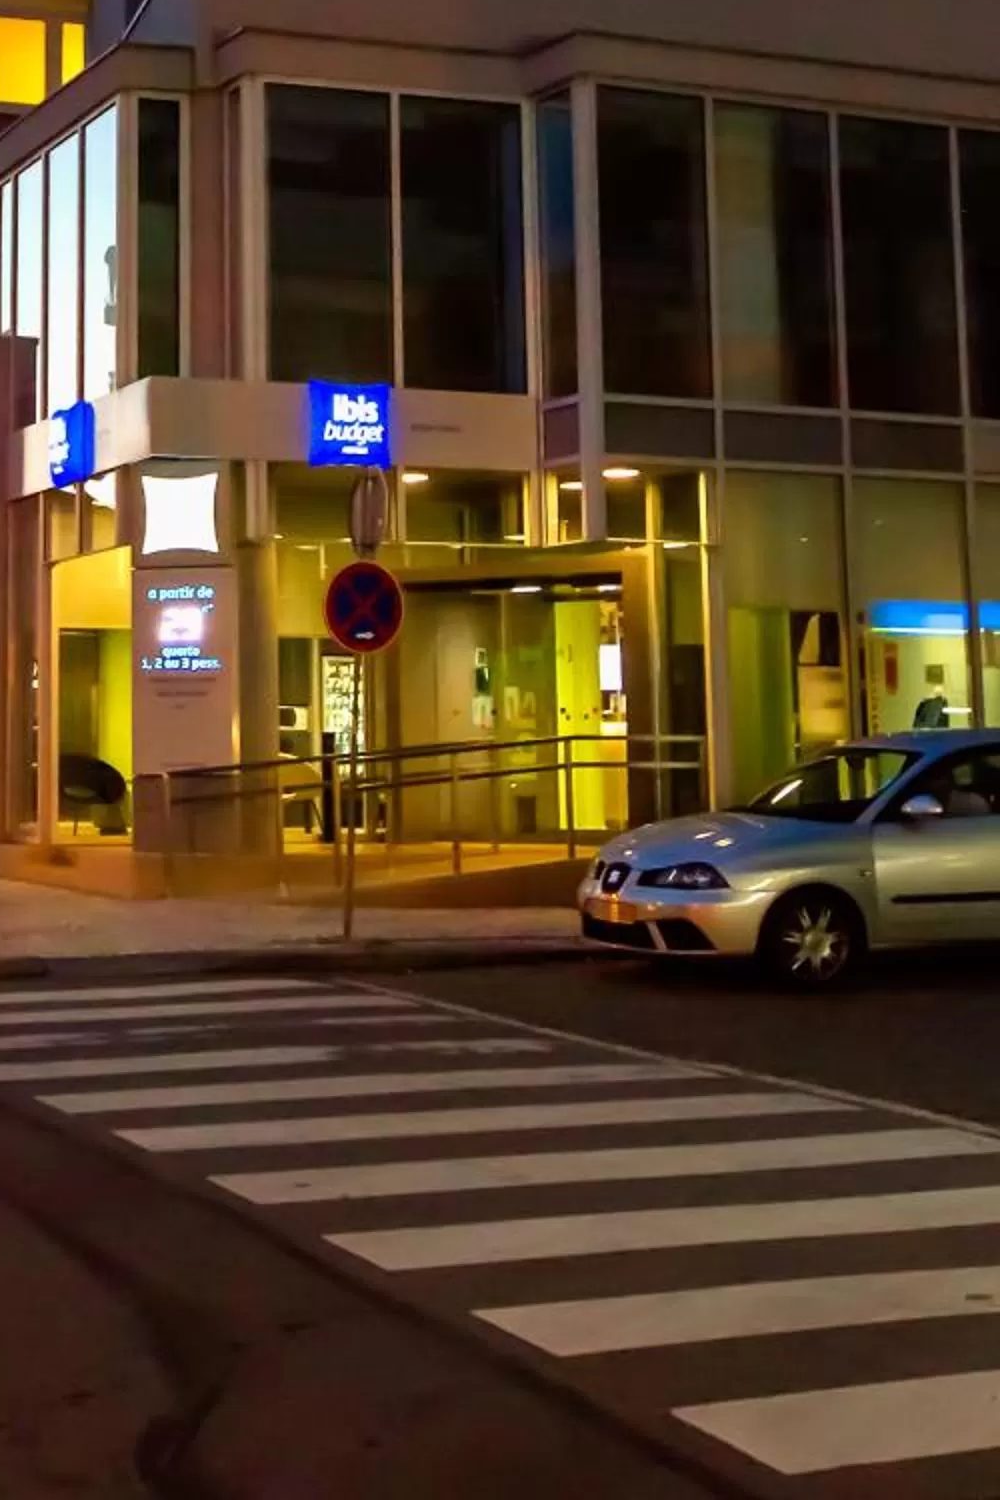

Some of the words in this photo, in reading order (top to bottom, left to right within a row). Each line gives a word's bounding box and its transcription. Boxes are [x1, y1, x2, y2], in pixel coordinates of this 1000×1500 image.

[332, 393, 379, 423] ibis
[323, 419, 385, 446] budget
[159, 586, 195, 601] partir
[197, 585, 214, 599] de
[154, 657, 163, 669] 2
[181, 657, 190, 669] 3
